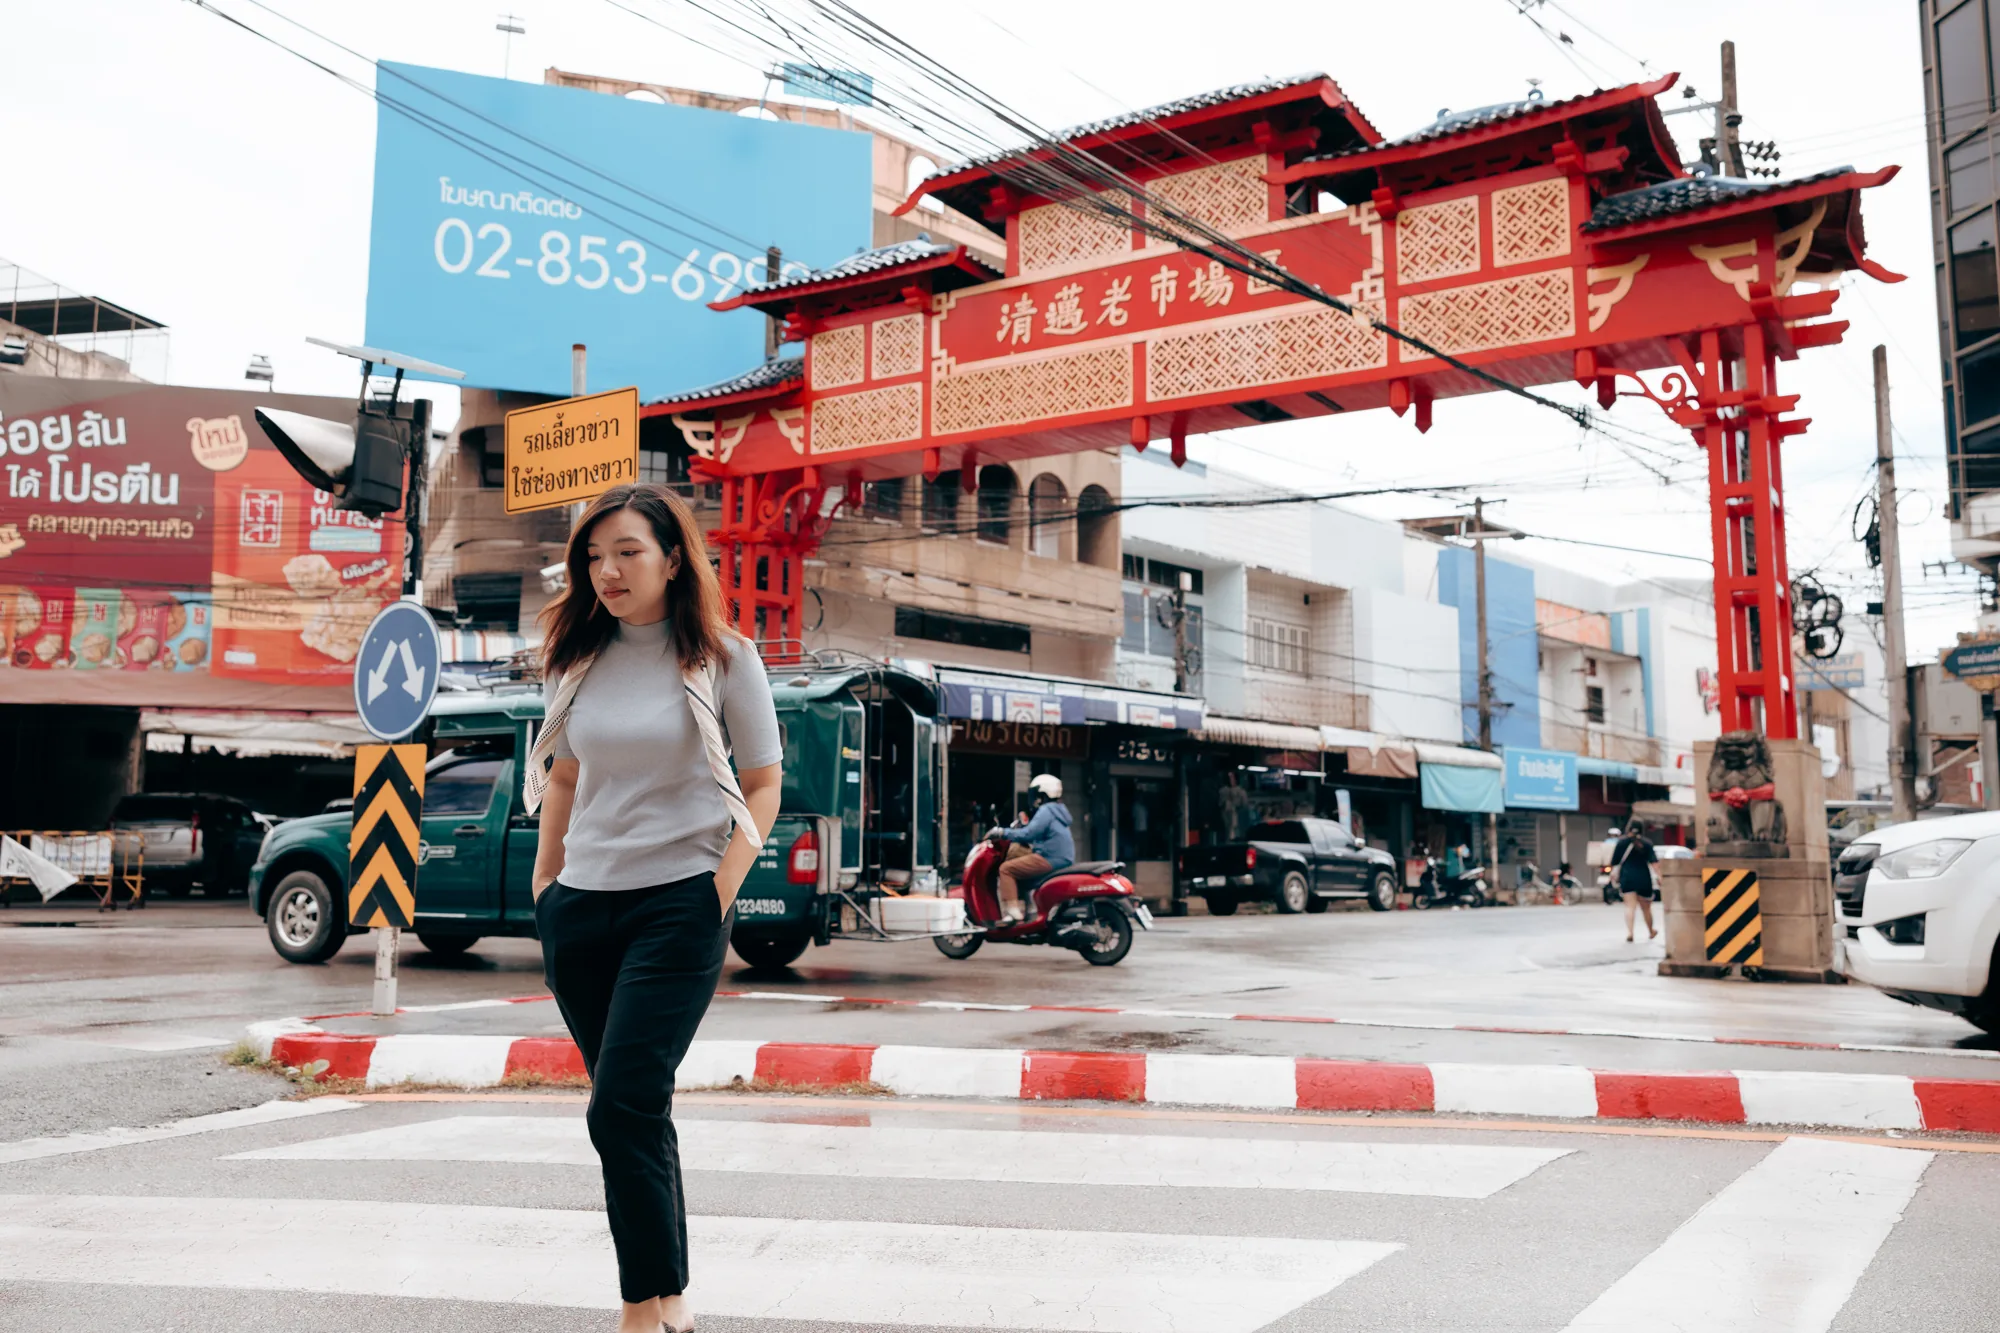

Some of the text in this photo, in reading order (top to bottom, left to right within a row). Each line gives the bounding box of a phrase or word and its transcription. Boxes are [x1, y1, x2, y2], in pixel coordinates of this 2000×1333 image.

[523, 412, 619, 454] รถเลี้ยวขวา
[511, 457, 633, 498] ใช้ช่องทางขวา
[27, 514, 195, 541] คลายทุกความหิว
